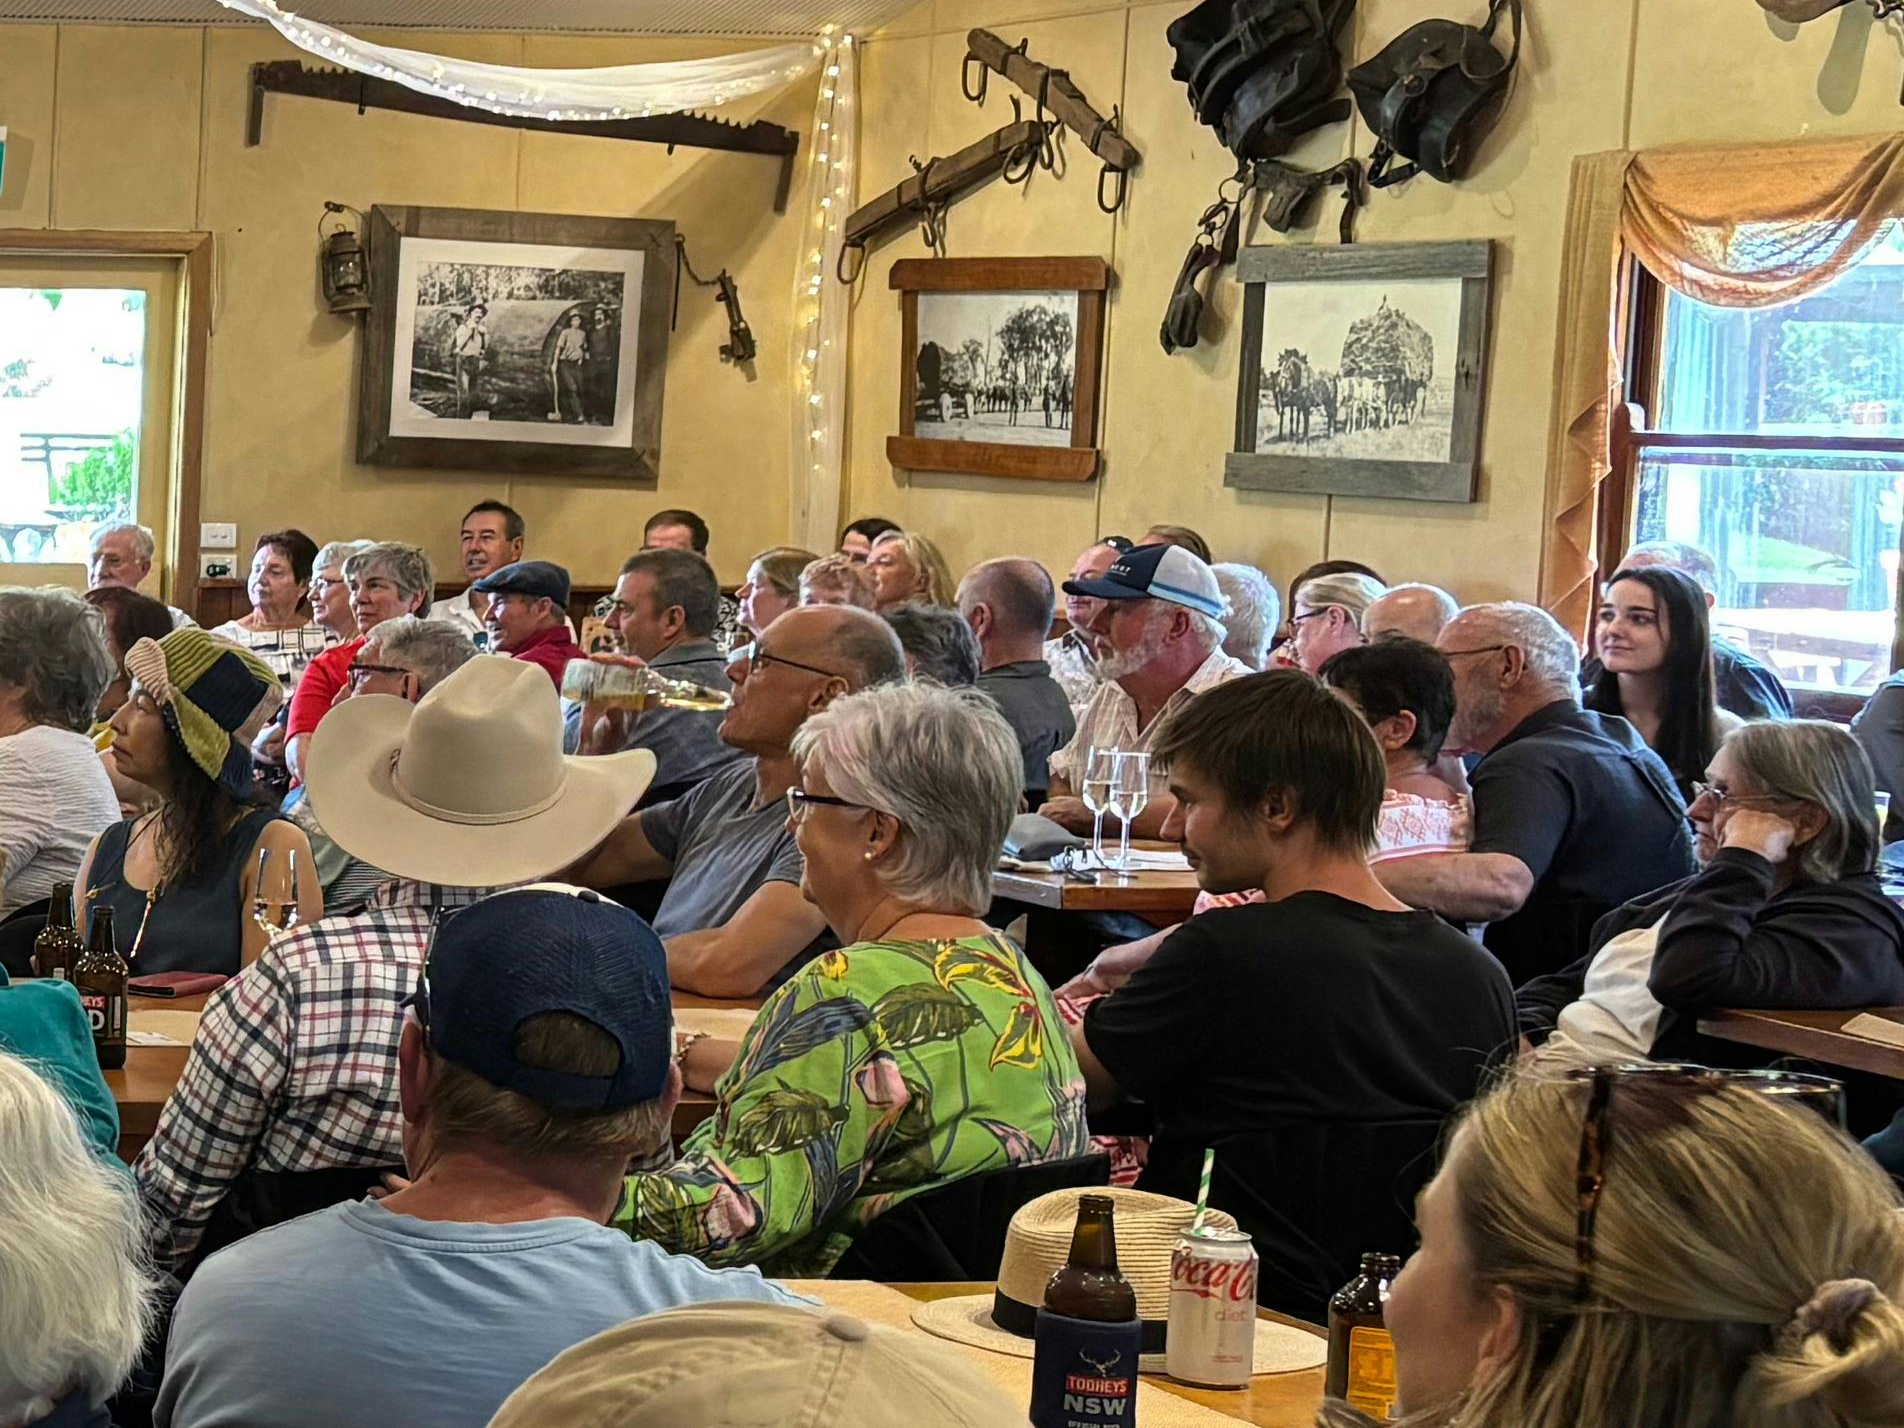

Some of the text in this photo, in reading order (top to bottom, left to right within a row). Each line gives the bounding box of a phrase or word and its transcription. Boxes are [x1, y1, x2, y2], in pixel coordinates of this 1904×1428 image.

[1214, 1308, 1249, 1322] diet
[1068, 1375, 1128, 1394] TOOHEYS
[1063, 1393, 1127, 1416] NSW
